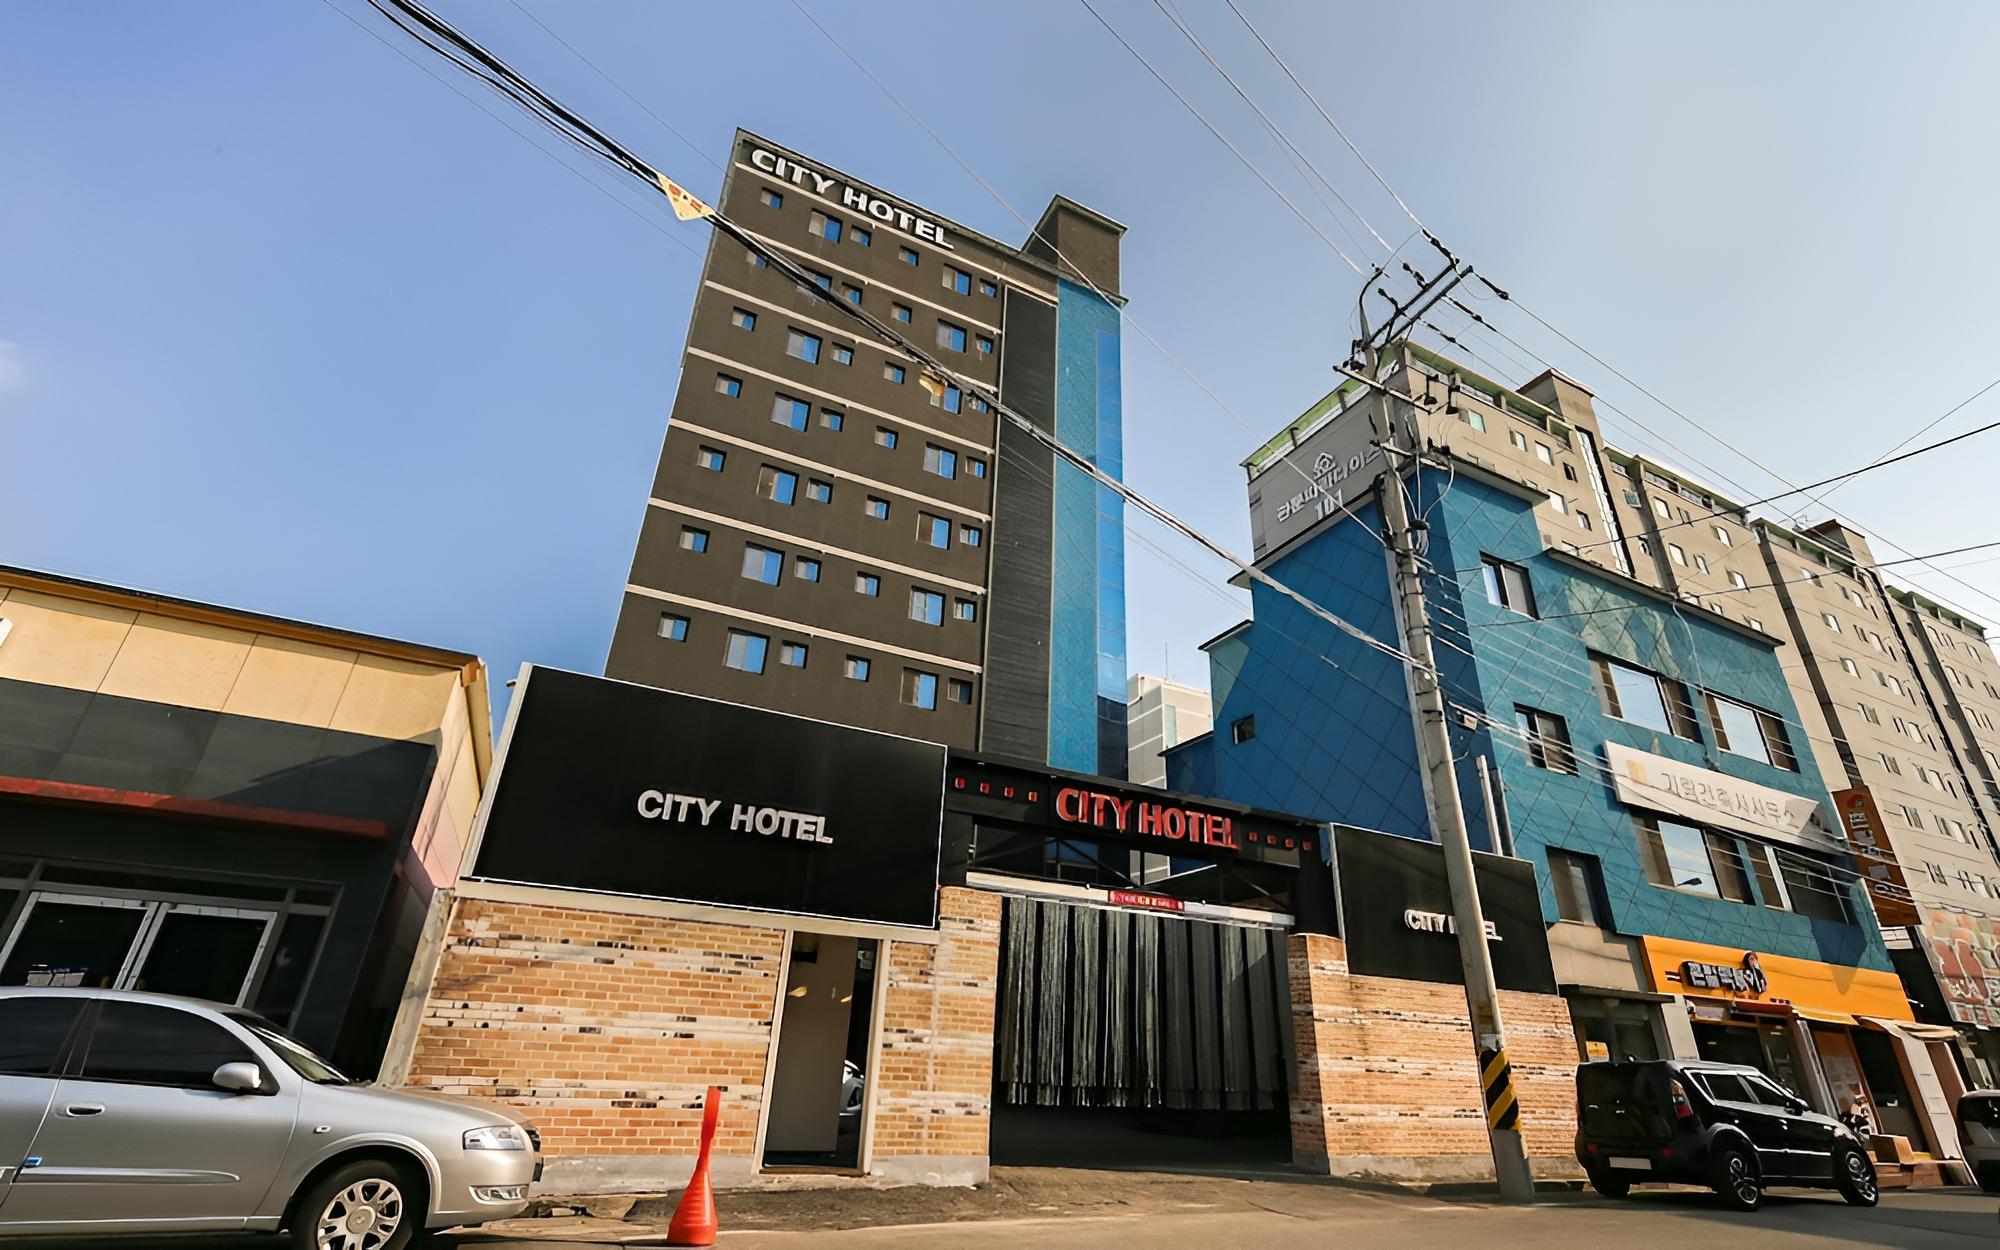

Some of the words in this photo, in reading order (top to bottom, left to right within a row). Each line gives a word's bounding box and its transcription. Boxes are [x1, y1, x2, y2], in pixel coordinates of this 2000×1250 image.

[751, 148, 836, 195] CITY
[843, 186, 954, 250] HOTEL
[637, 789, 722, 826] CITY
[730, 804, 834, 844] HOTEL
[1056, 787, 1132, 832] CITY
[1138, 802, 1240, 849] HOTEL
[1404, 909, 1446, 933] CITY
